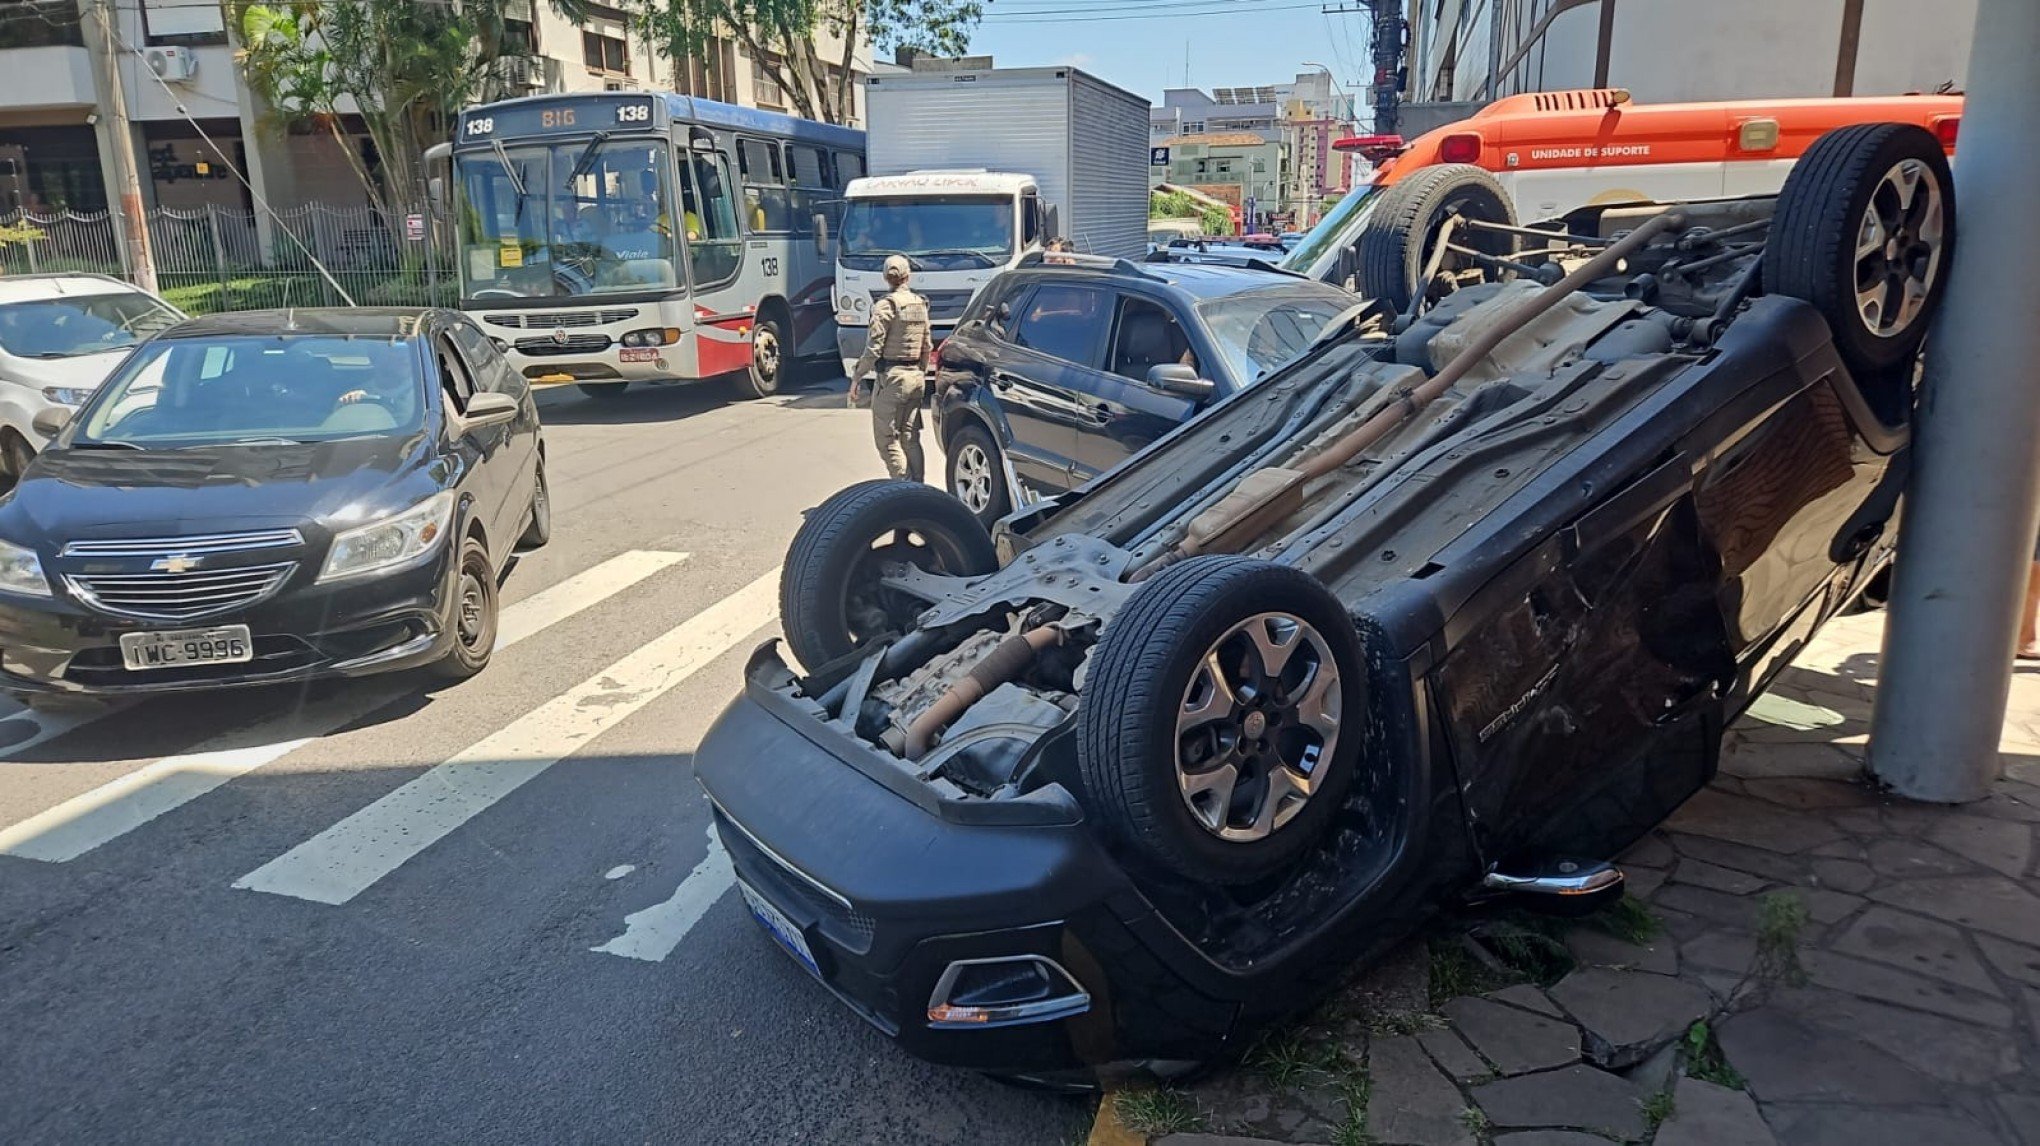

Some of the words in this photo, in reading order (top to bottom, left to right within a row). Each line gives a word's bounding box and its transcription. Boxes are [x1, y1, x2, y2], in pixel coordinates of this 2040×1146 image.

[467, 118, 494, 136] 138
[541, 109, 576, 128] BIG
[616, 105, 649, 122] 138
[1531, 148, 1581, 160] UNIDADE
[1584, 148, 1598, 158] DE
[1600, 145, 1650, 157] SUPORTE
[761, 256, 779, 278] 138
